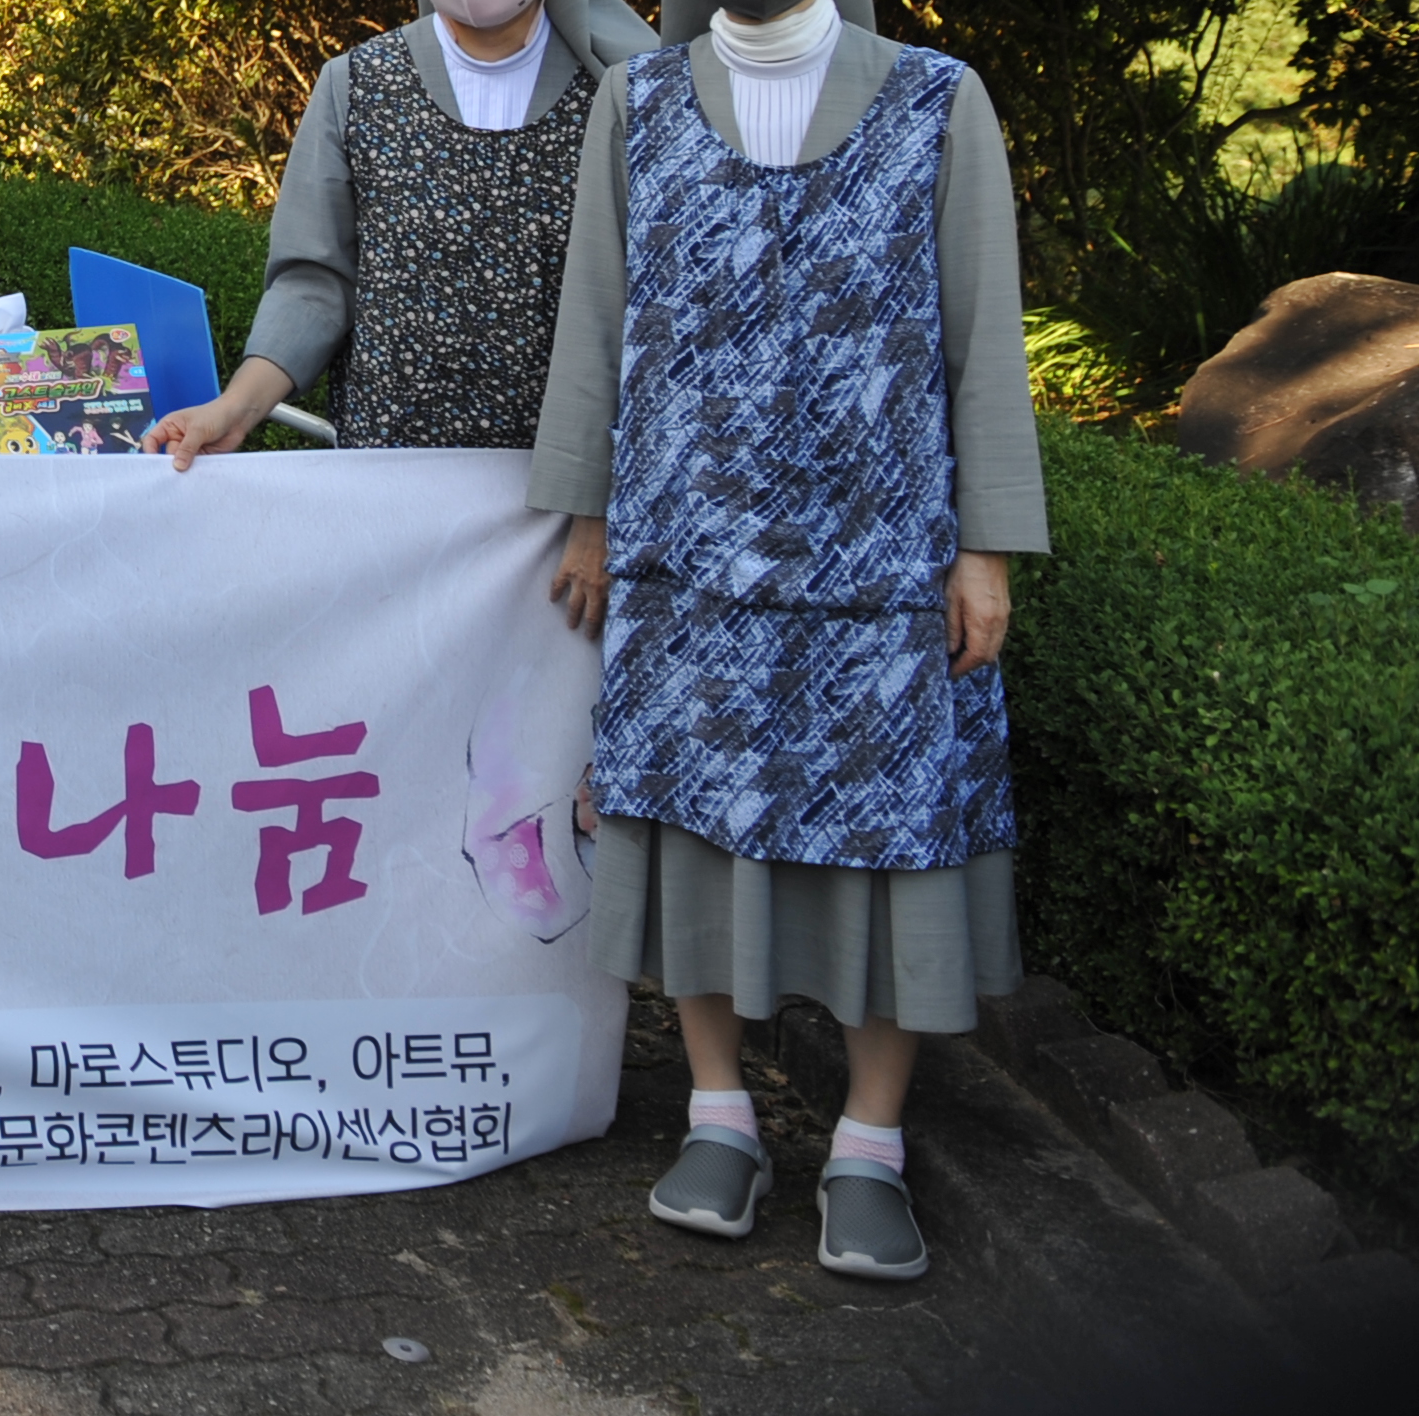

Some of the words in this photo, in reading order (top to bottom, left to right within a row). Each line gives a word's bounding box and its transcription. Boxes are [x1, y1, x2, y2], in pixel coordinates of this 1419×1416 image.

[17, 686, 379, 914] 나눔
[31, 1036, 325, 1095] 마로스튜디오,
[353, 1033, 509, 1088] 아트뮤,
